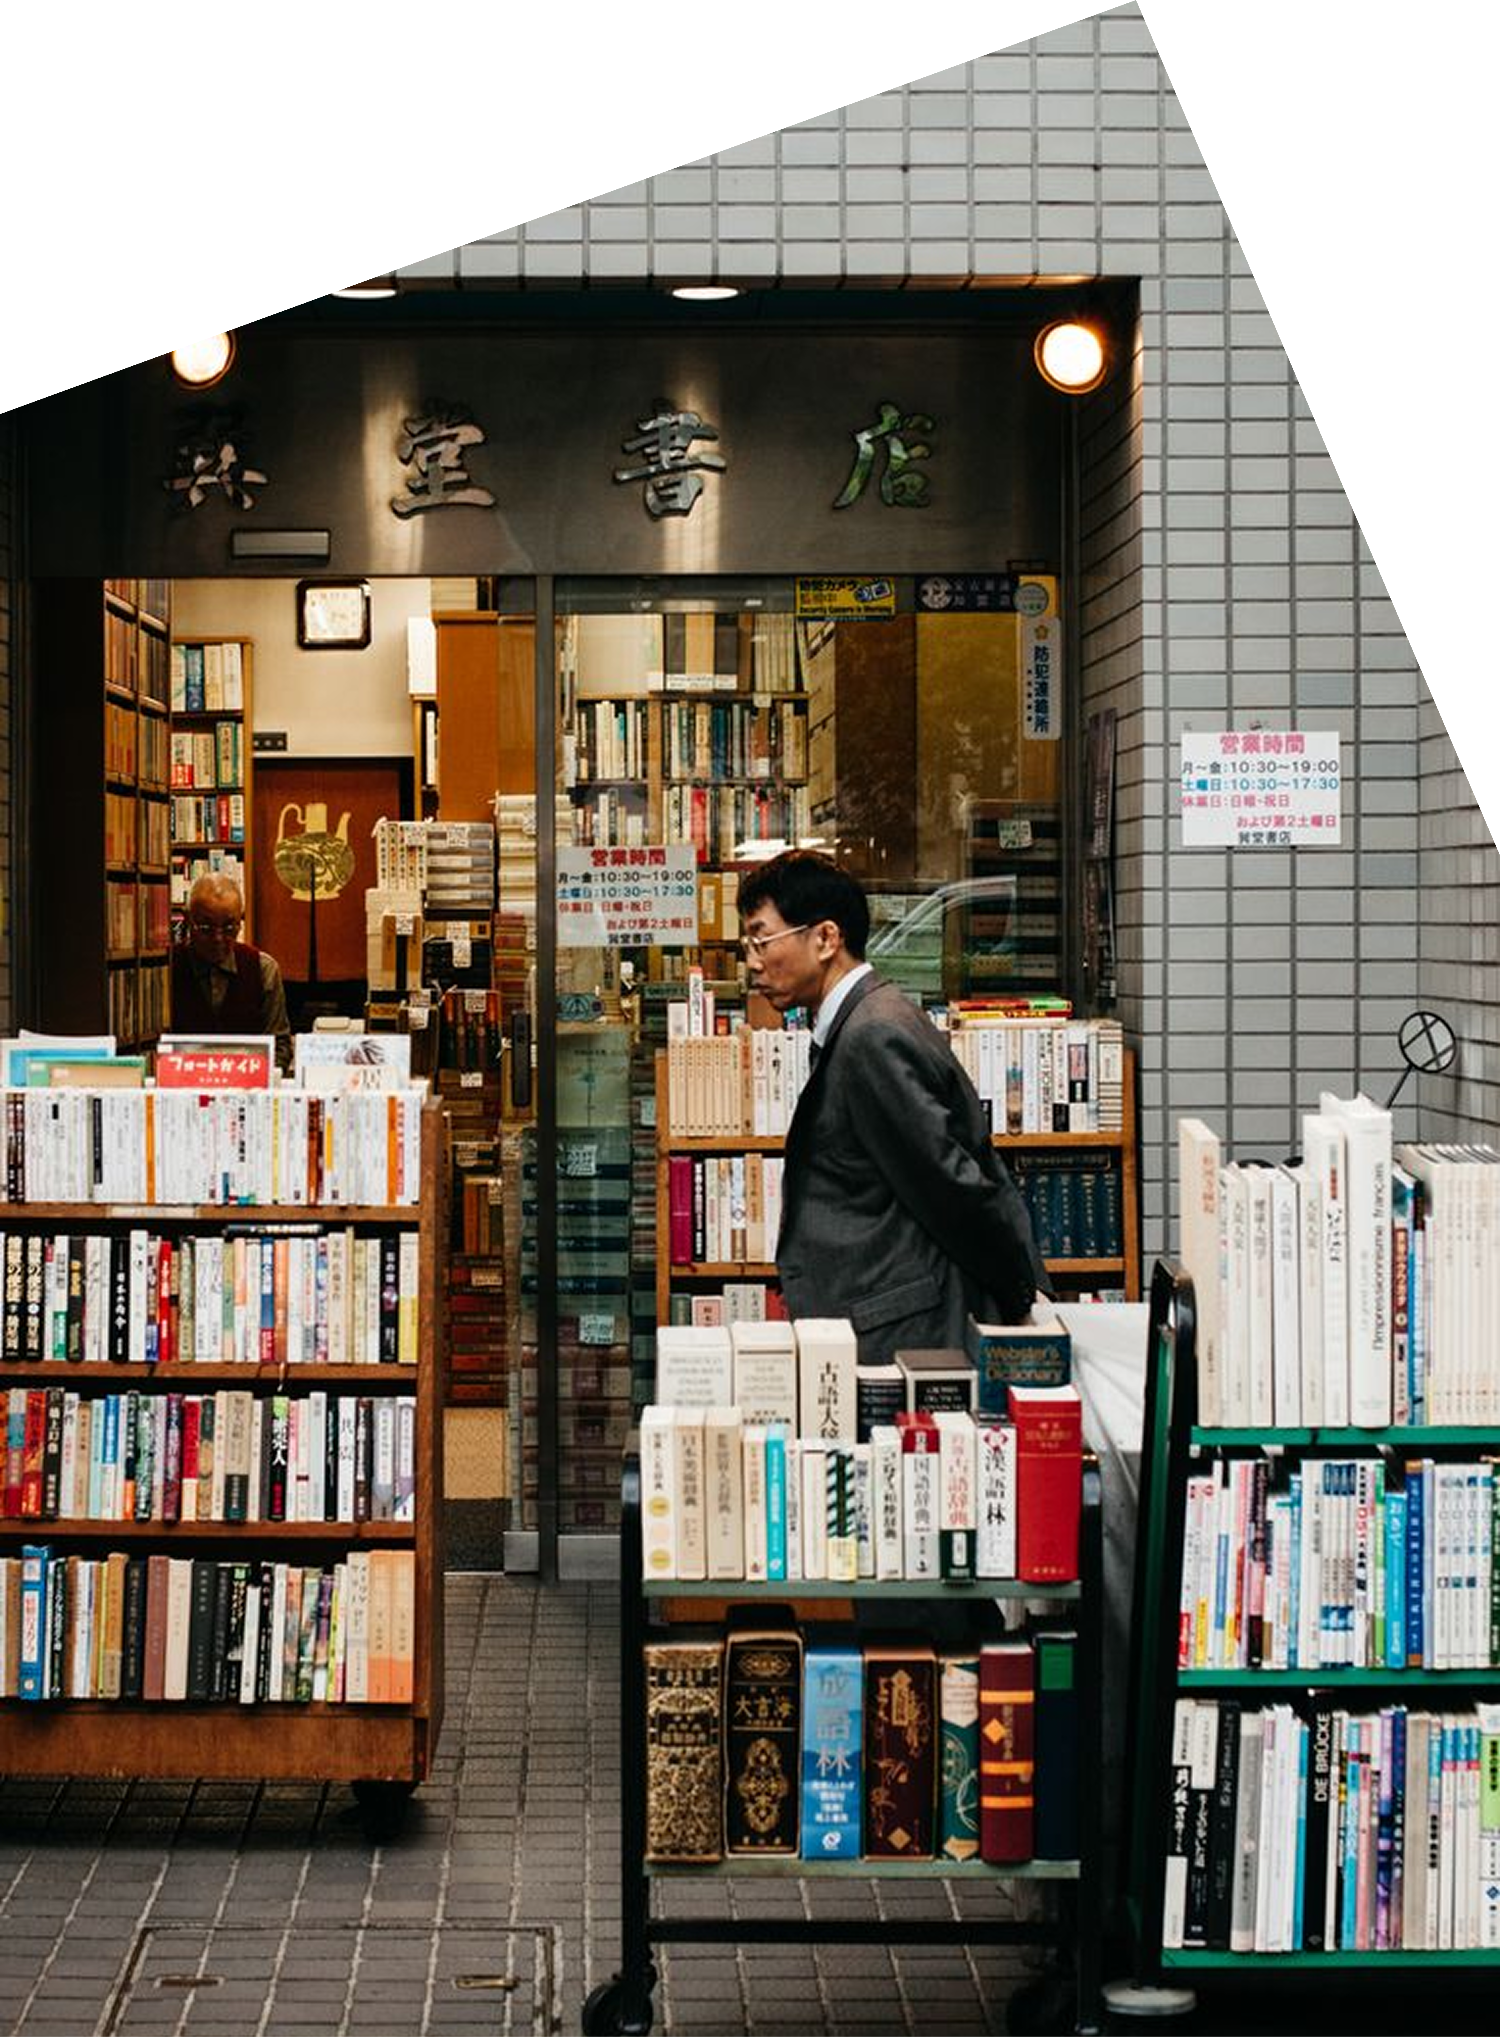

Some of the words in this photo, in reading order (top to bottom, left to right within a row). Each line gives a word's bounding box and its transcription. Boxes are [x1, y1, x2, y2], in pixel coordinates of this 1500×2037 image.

[1220, 734, 1305, 755] 営業時間
[591, 848, 666, 867] 営業時間
[734, 1694, 794, 1719] 大言海
[1313, 1712, 1331, 1774] BRÜCKE
[1314, 1777, 1328, 1803] DIE
